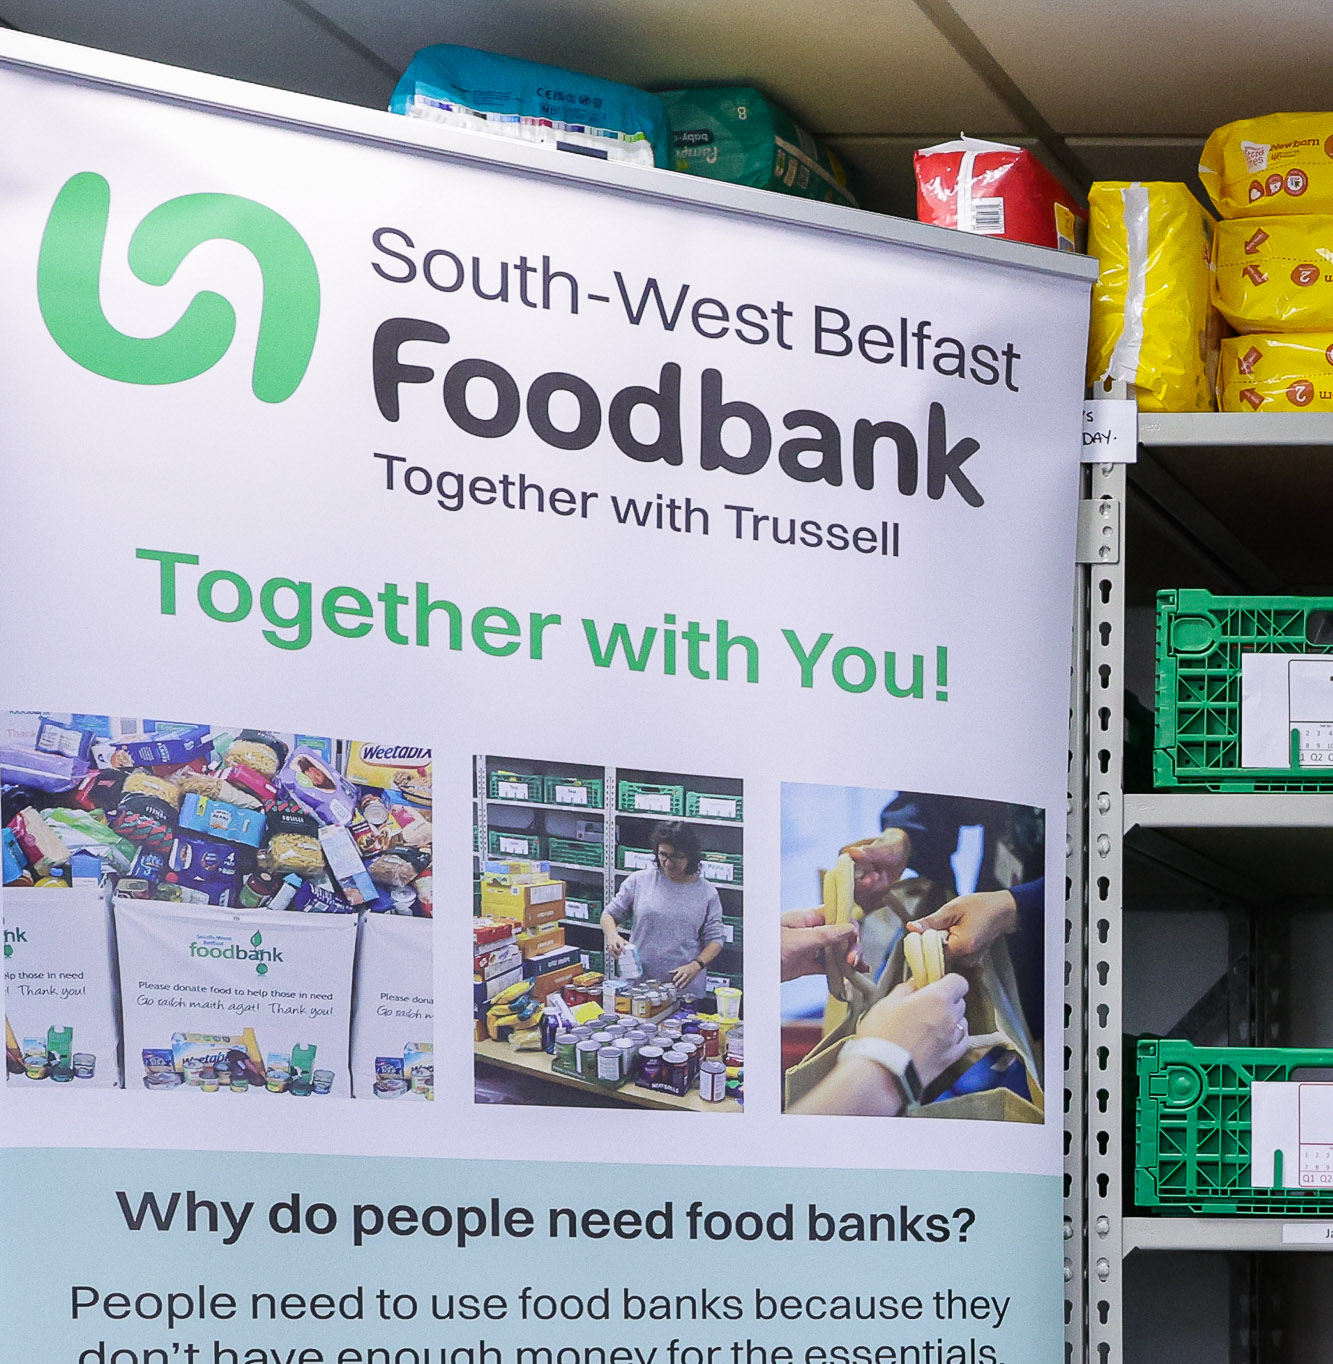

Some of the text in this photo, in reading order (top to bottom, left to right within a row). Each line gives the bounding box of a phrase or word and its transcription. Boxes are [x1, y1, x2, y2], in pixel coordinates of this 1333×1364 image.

[371, 226, 1021, 394] South-West Belfast
[373, 318, 985, 509] Foodbank
[373, 454, 901, 559] Together with Trussell
[135, 550, 949, 701] Together with You!
[139, 981, 170, 993] Please
[174, 984, 207, 993] donate
[211, 984, 231, 994] food
[234, 988, 244, 996] to
[246, 988, 267, 998] help
[270, 988, 296, 999] those
[310, 992, 333, 1000] need
[189, 942, 283, 963] foodbank
[117, 1190, 977, 1245] Why do people need food banks?
[70, 1286, 1010, 1329] People need to use food banks because they
